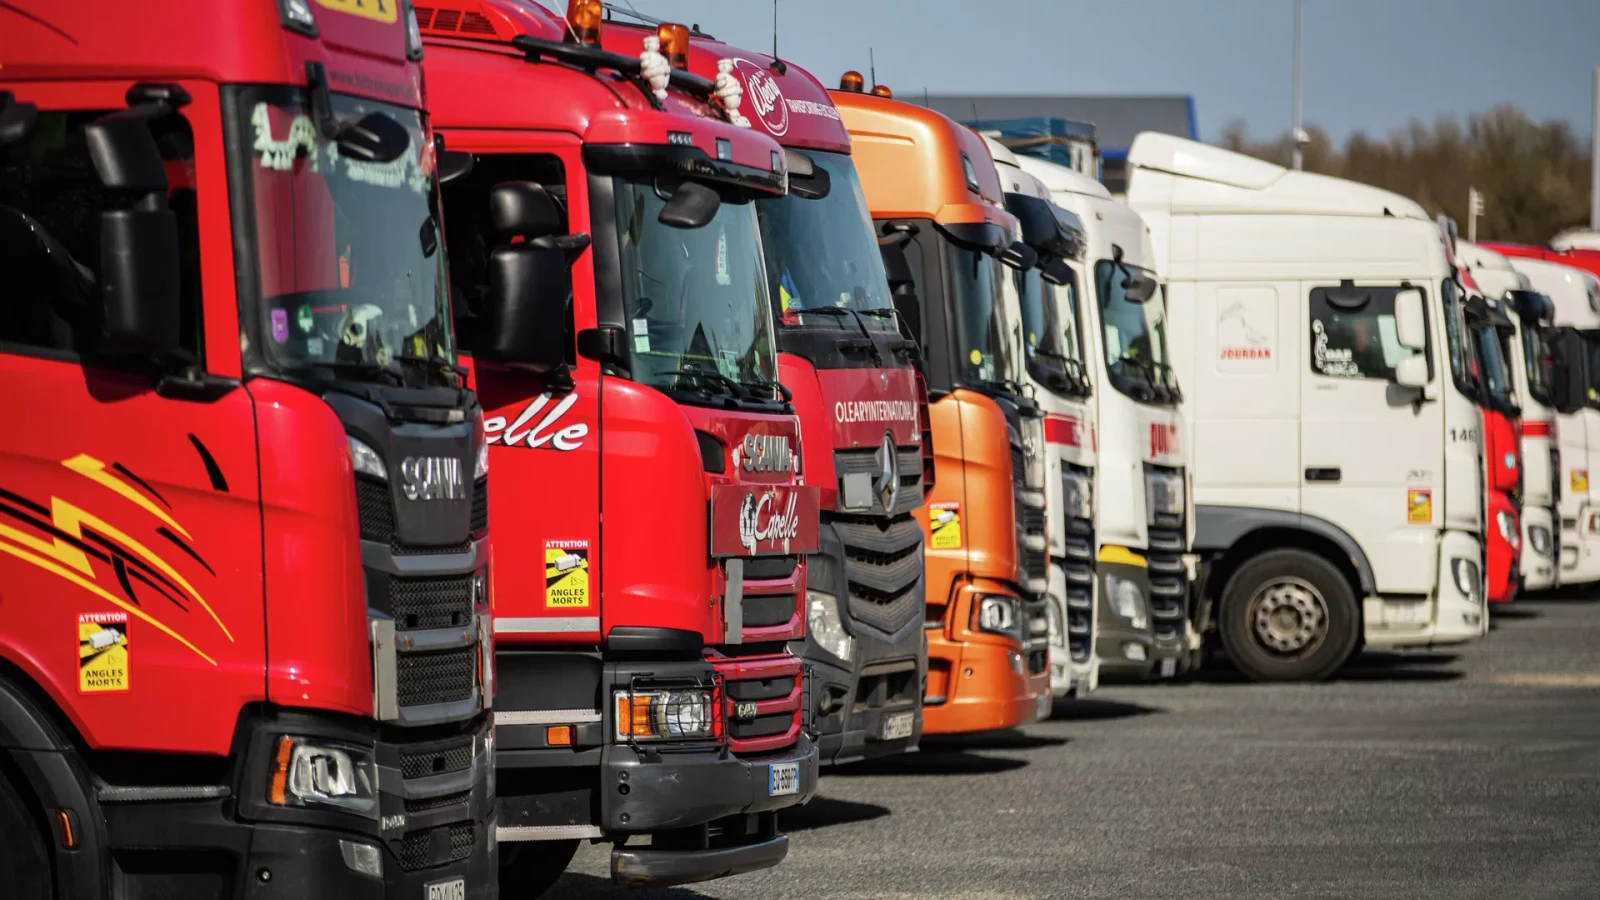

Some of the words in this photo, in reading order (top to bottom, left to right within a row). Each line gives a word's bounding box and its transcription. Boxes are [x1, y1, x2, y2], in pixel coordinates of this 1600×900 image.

[1219, 348, 1271, 360] JOURDAN
[743, 433, 792, 473] SCANIA
[401, 456, 466, 500] SCANIA
[545, 540, 588, 548] ATTENTION
[550, 588, 585, 597] ANGLES
[552, 596, 584, 605] MORTS
[78, 613, 127, 623] ATTENTION
[85, 669, 124, 679] ANGLES
[87, 678, 122, 687] MORTS
